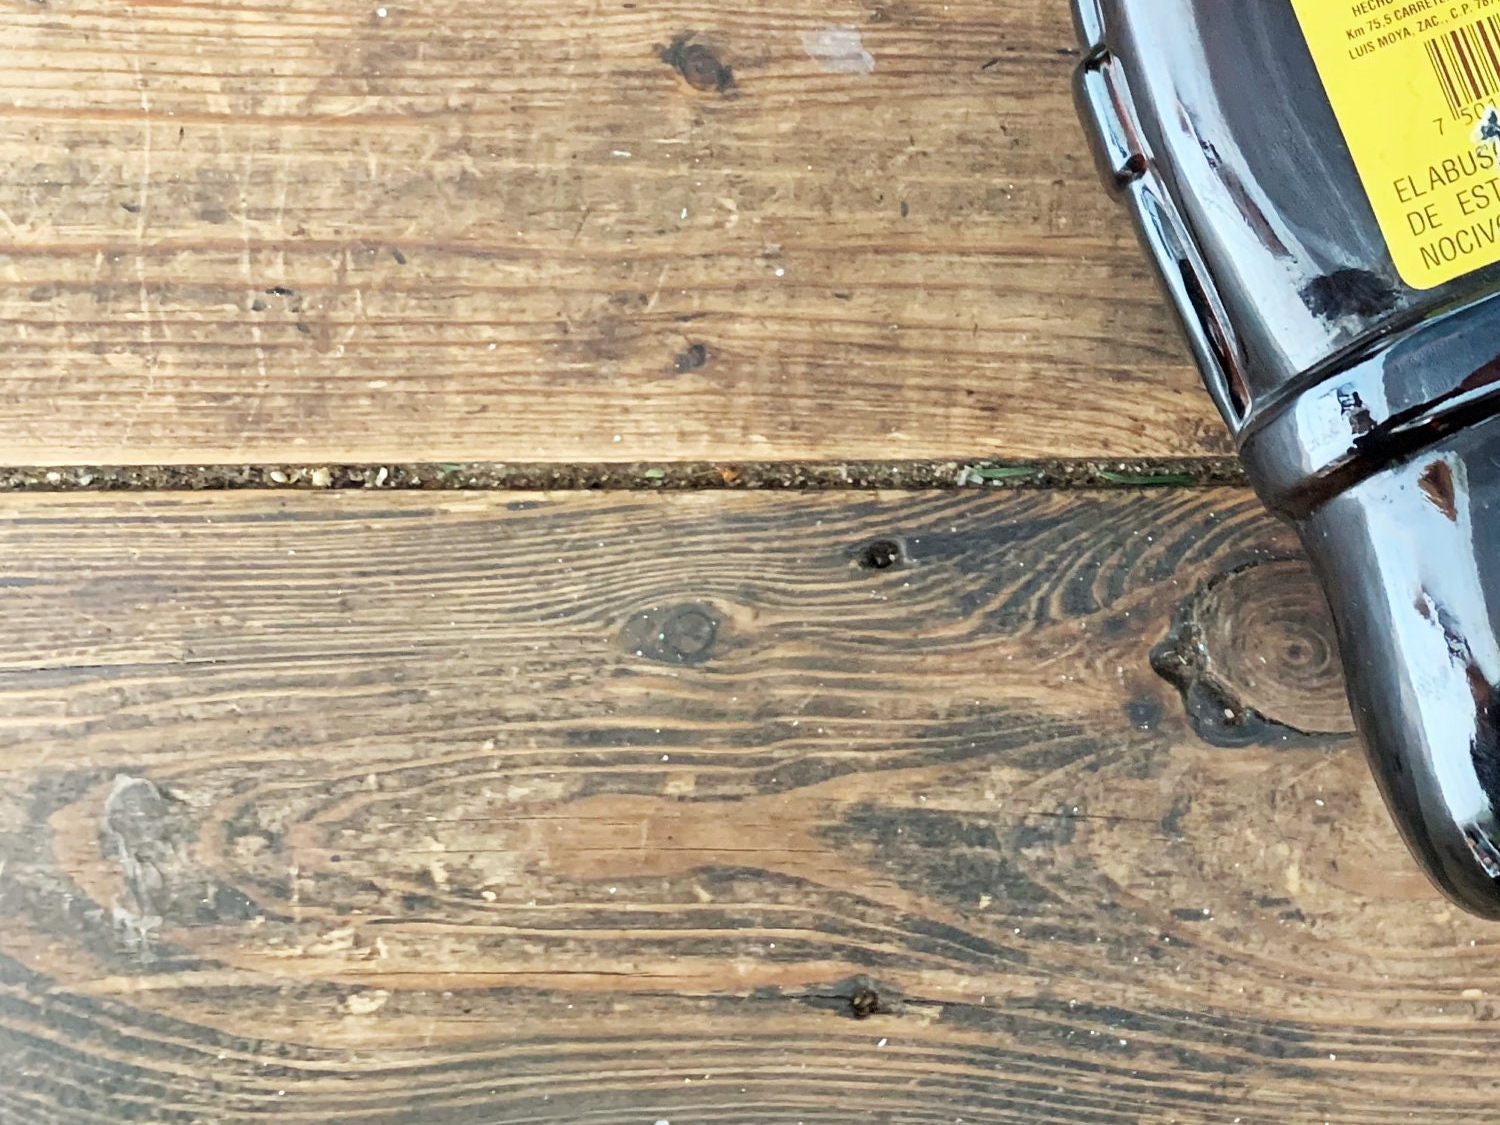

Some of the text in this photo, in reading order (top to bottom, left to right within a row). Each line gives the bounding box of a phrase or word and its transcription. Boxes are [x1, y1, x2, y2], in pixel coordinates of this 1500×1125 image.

[1346, 27, 1365, 40] Km
[1348, 41, 1375, 60] LUIS
[1450, 3, 1472, 19] C.P.
[1432, 117, 1444, 136] 7
[1393, 175, 1427, 203] EL
[1428, 142, 1500, 191] ABUS
[1406, 203, 1443, 237] DE
